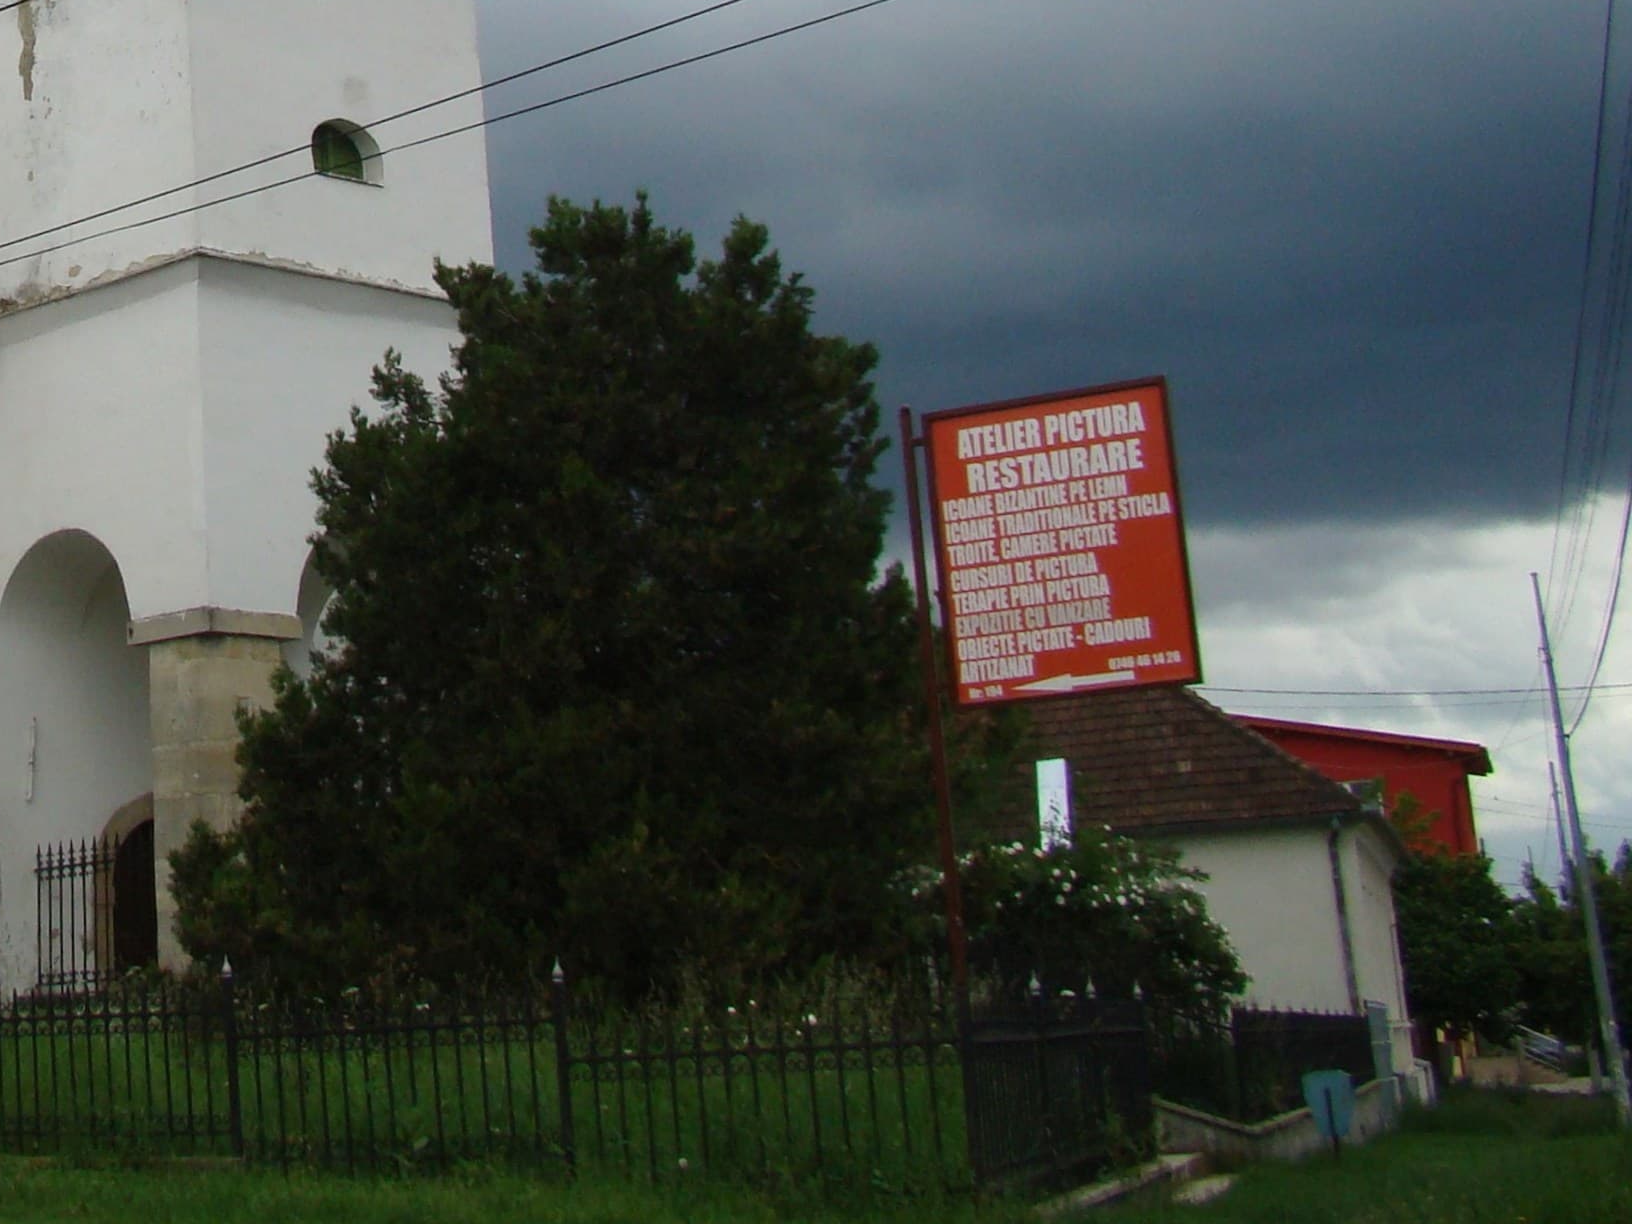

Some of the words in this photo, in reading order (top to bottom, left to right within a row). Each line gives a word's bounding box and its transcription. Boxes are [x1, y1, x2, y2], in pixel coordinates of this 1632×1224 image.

[958, 420, 1041, 459] ATELIER
[1045, 402, 1145, 446] PICTURA
[967, 439, 1143, 493] RESTAURARE
[942, 496, 993, 522] ICOANE
[995, 484, 1067, 514] BIZANTINE
[1069, 480, 1087, 500] PE
[1088, 476, 1127, 498] LEMN
[945, 519, 995, 544] ICOANE
[997, 503, 1097, 534] TRADITIONALE
[1099, 500, 1118, 521] PE
[1119, 493, 1170, 519] STICLA
[1001, 531, 1056, 556] CAMERE
[1059, 524, 1117, 551] PICTATE
[950, 562, 1012, 592] CURSURI
[1015, 560, 1034, 581] DE
[1035, 552, 1098, 579] PICTURA
[952, 587, 1009, 615] TERAPIE
[1011, 584, 1044, 608] PRIN
[1047, 575, 1109, 604] PICTURA
[956, 609, 1022, 638] EXPOZITIE
[1026, 606, 1046, 628] CU
[1048, 599, 1111, 625] VANZARE
[958, 633, 1016, 659] OBIECTE
[1017, 625, 1075, 652] PICTATE
[1084, 617, 1150, 644] CADOURI
[960, 655, 1034, 684] ARTIZANAT
